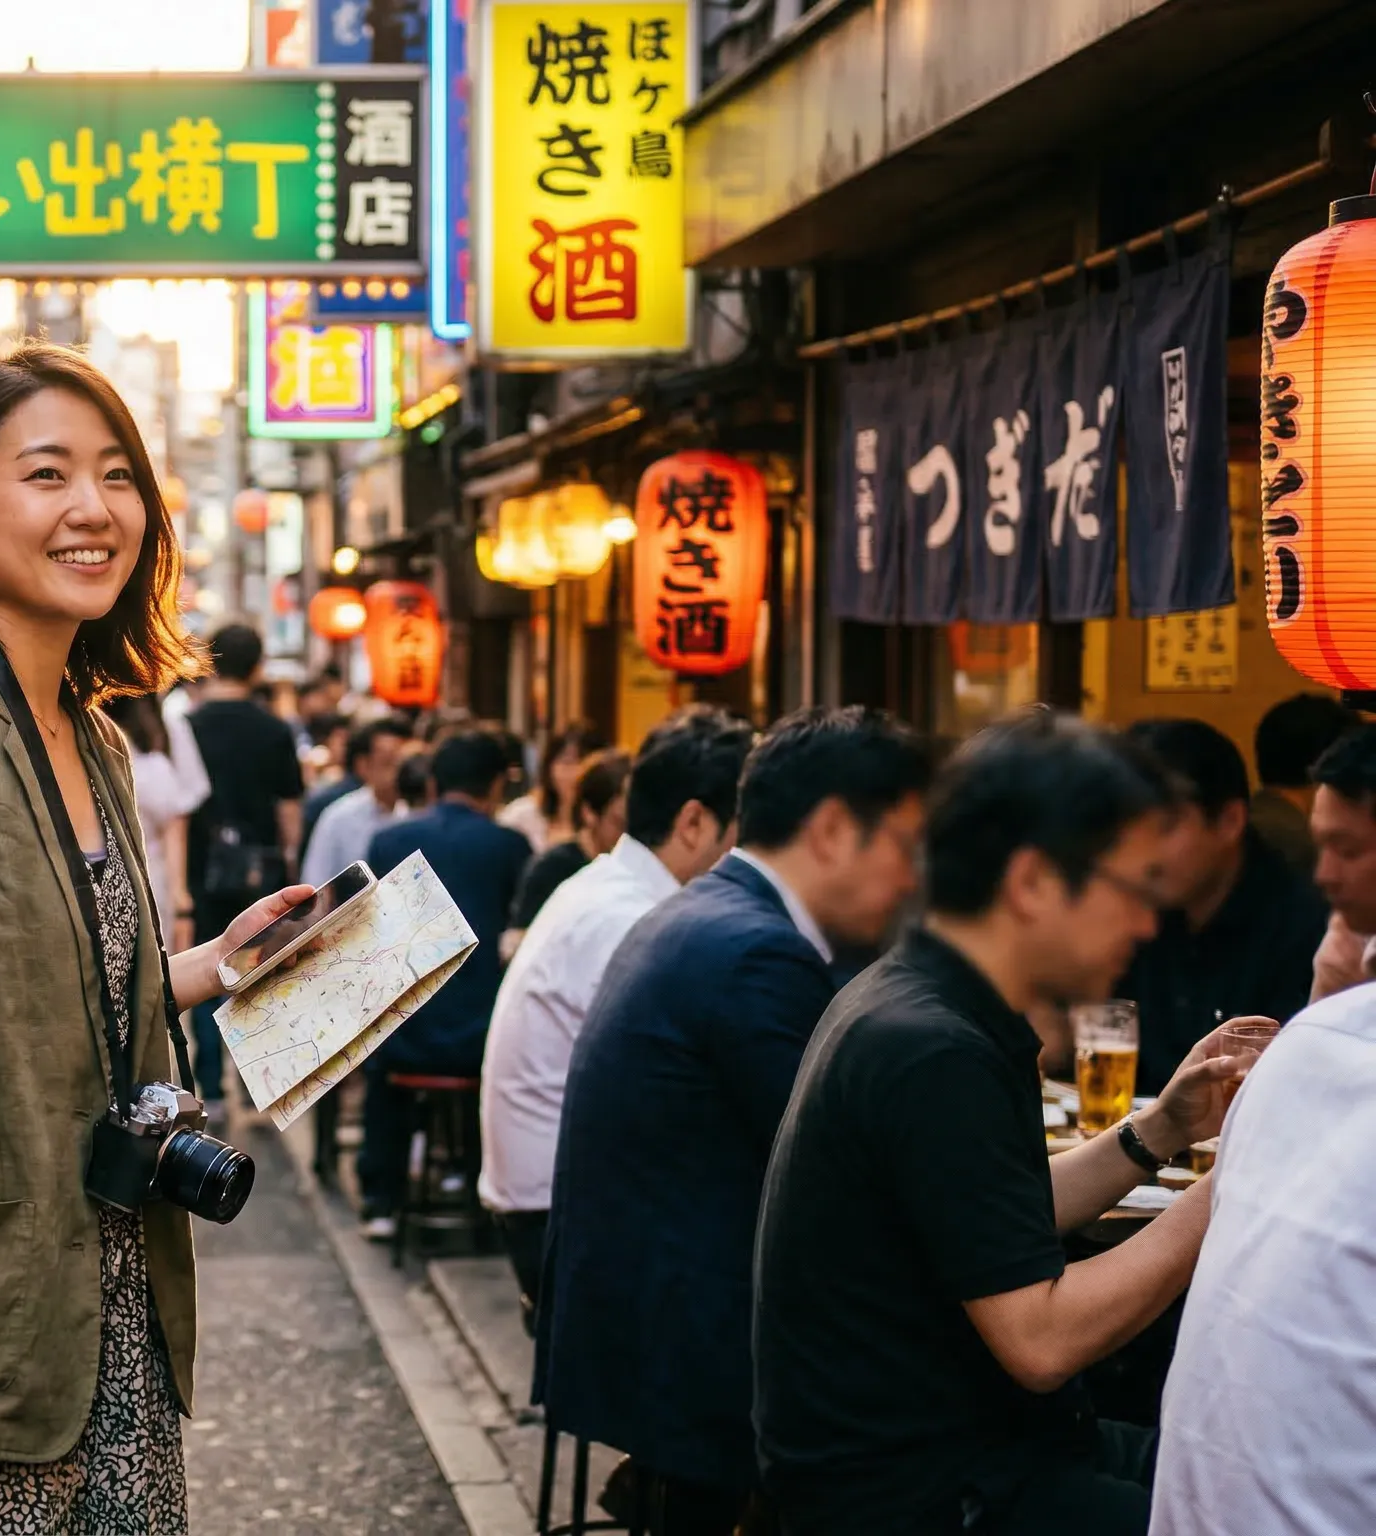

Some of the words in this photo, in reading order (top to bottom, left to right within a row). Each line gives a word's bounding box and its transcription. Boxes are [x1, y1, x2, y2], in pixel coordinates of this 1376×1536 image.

[344, 98, 414, 247] 酒店
[907, 385, 1115, 556] つぎだ
[657, 471, 736, 656] 焼き酒
